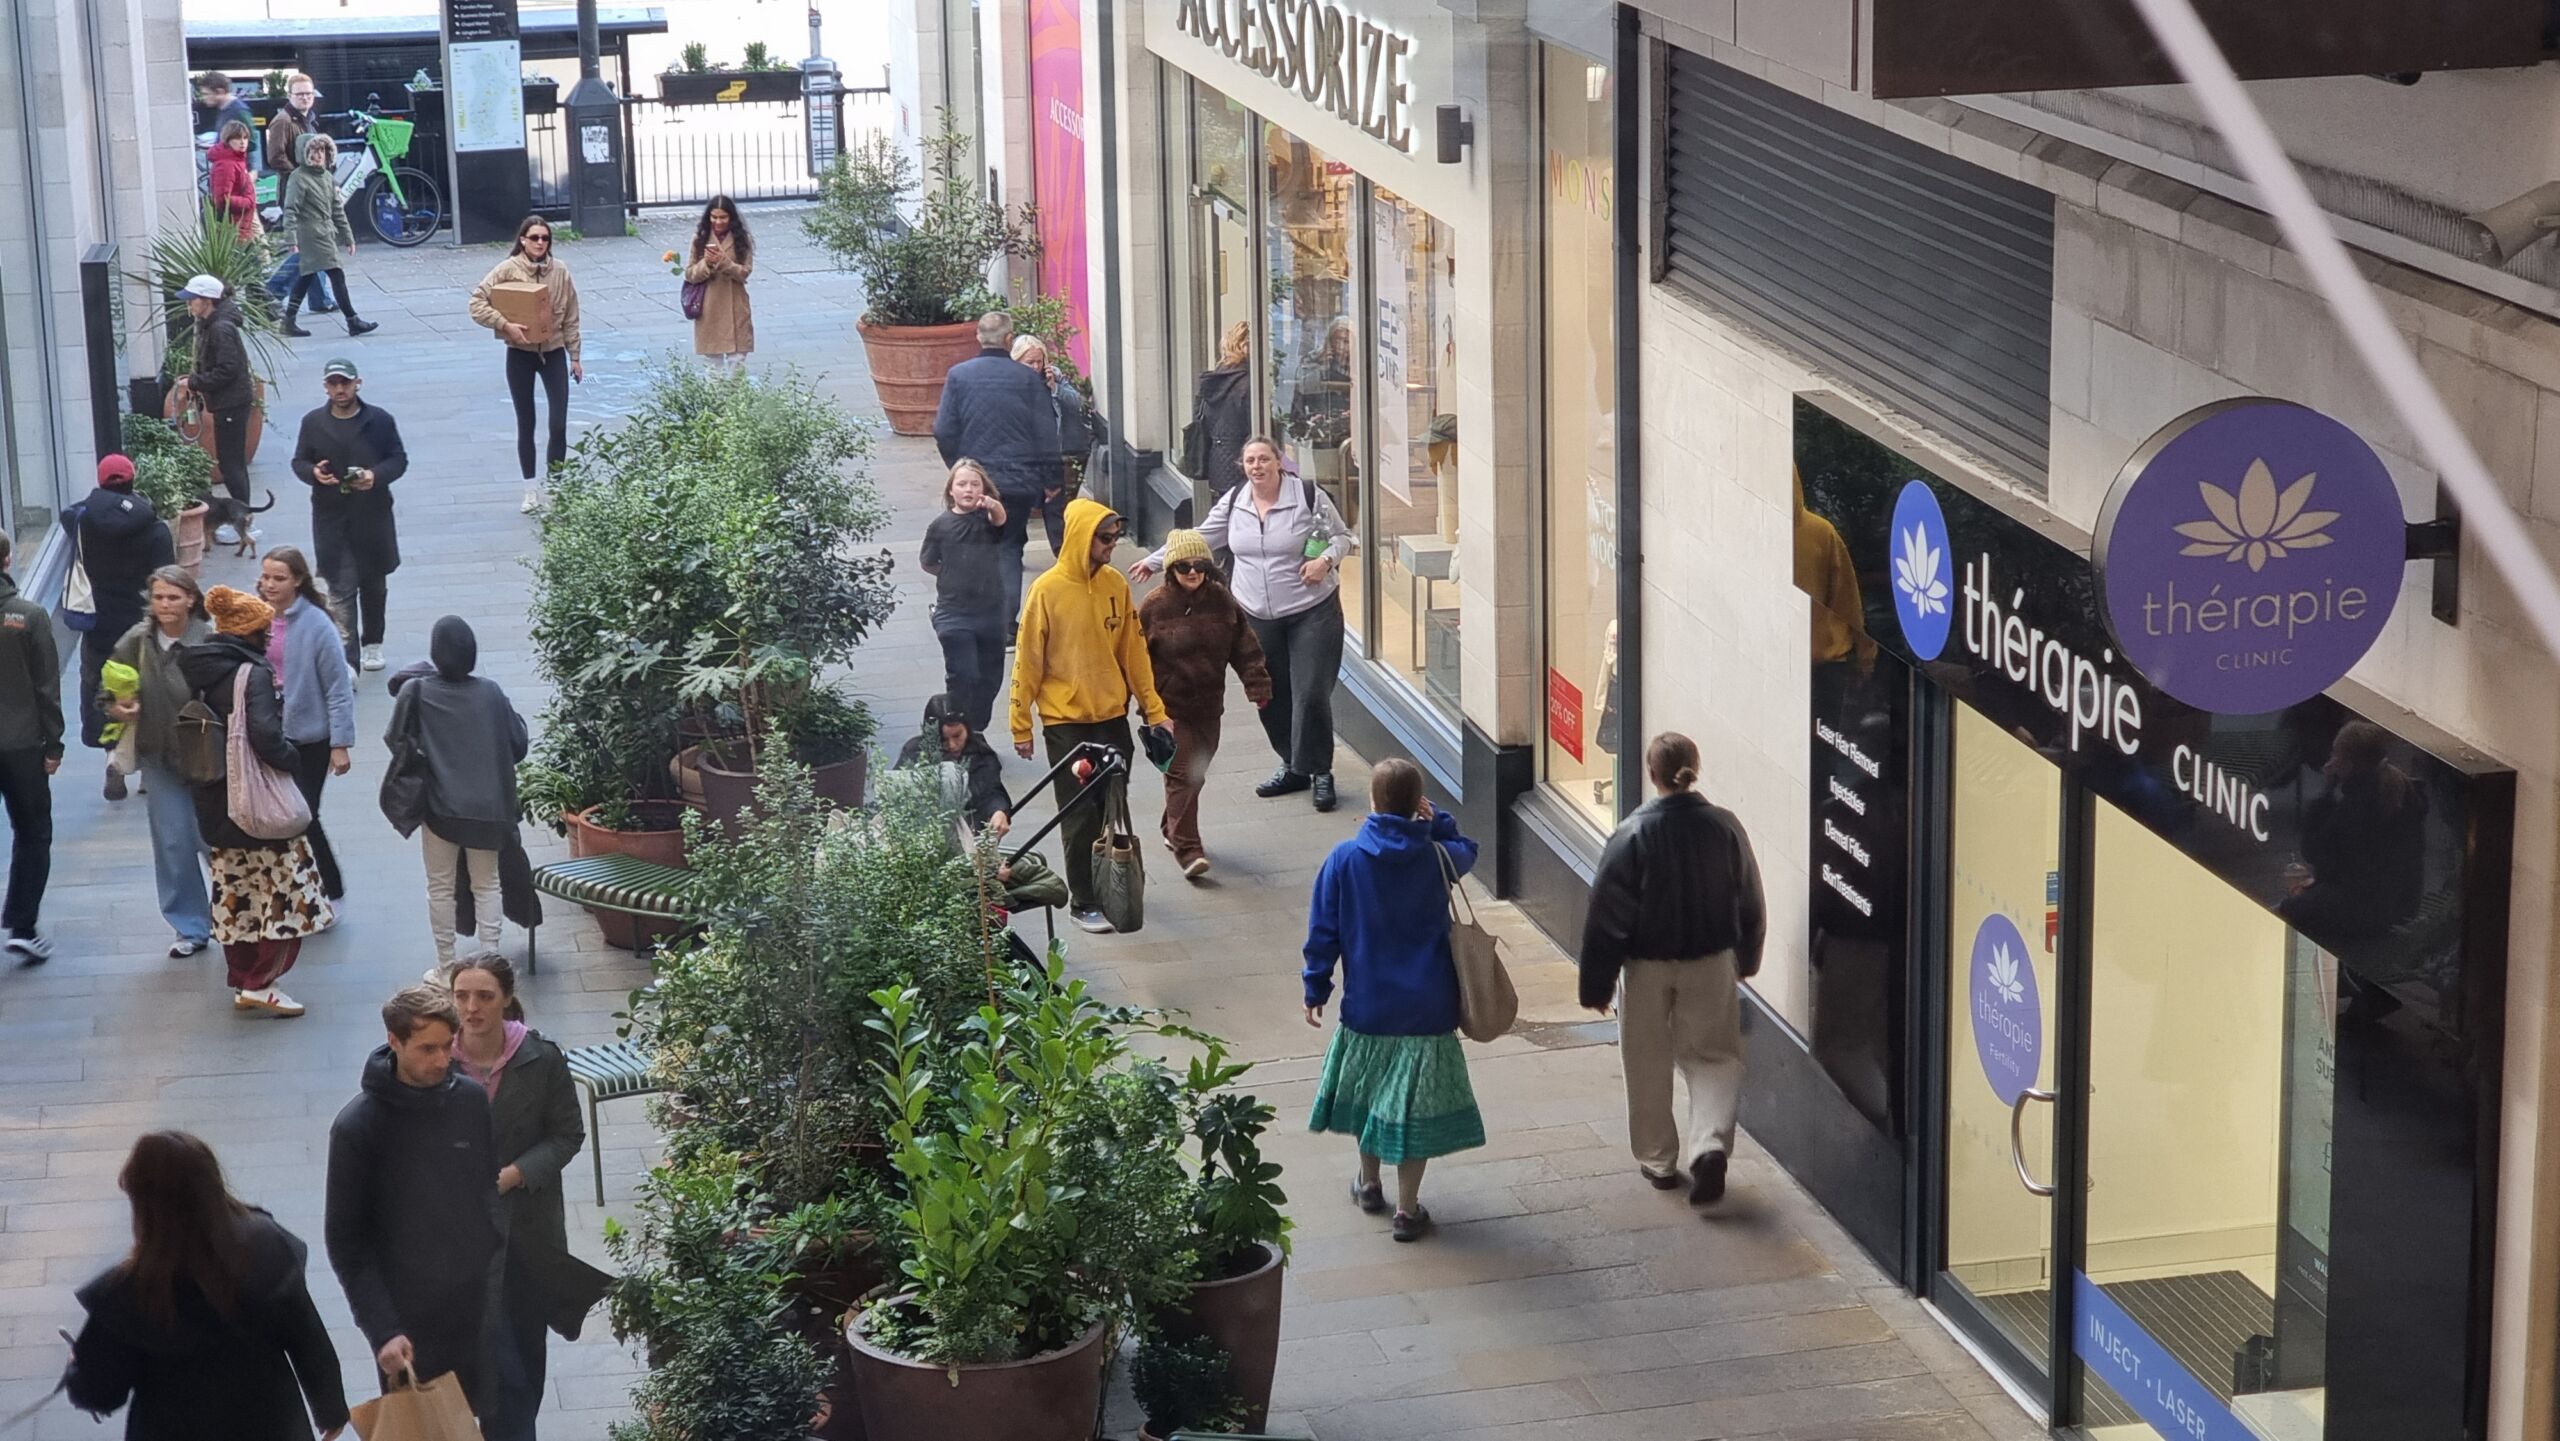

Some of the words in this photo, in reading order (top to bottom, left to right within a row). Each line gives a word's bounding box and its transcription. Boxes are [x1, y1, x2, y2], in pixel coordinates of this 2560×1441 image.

[2143, 580, 2368, 639] thérapie
[2216, 648, 2293, 670] CLINIC
[1963, 552, 2141, 755] thérapie
[2173, 745, 2269, 842] CLINIC
[1817, 718, 1835, 746] Laser
[1835, 732, 1849, 756] Hair
[1850, 742, 1880, 779] Removal
[1830, 775, 1865, 816] Injectables
[1825, 818, 1850, 854] Dermal
[1849, 836, 1870, 868] Fillers
[1979, 989, 2032, 1052] thérapie
[1989, 1043, 2020, 1076] Fertility
[2090, 1314, 2141, 1381] INJECT
[2157, 1379, 2206, 1441] LASER
